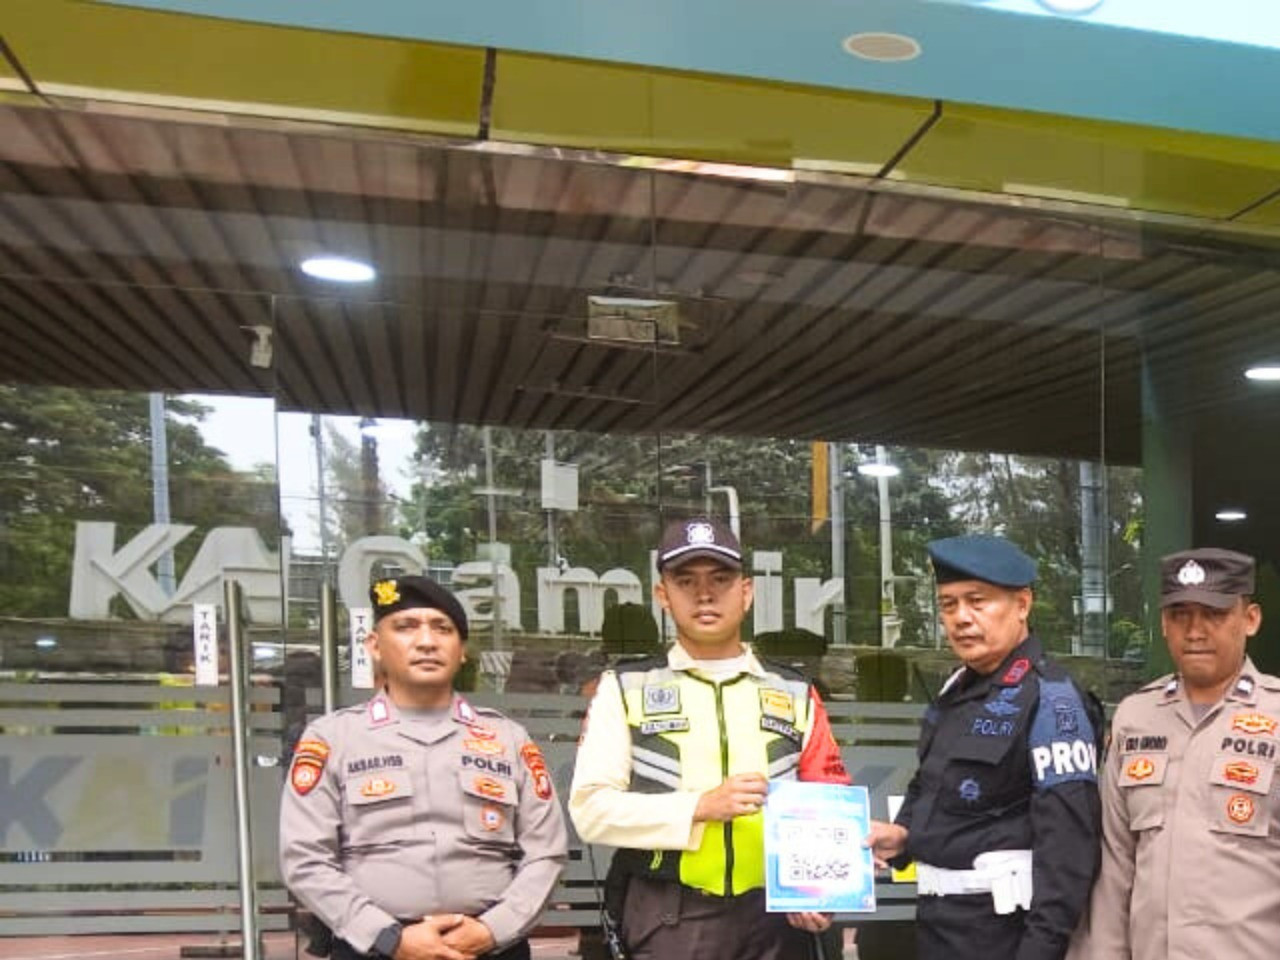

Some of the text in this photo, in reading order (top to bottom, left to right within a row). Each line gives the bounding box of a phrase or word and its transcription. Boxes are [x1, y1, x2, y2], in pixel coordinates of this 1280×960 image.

[339, 534, 845, 640] Gamir
[1221, 737, 1275, 759] POLRI
[461, 755, 512, 777] POLRI
